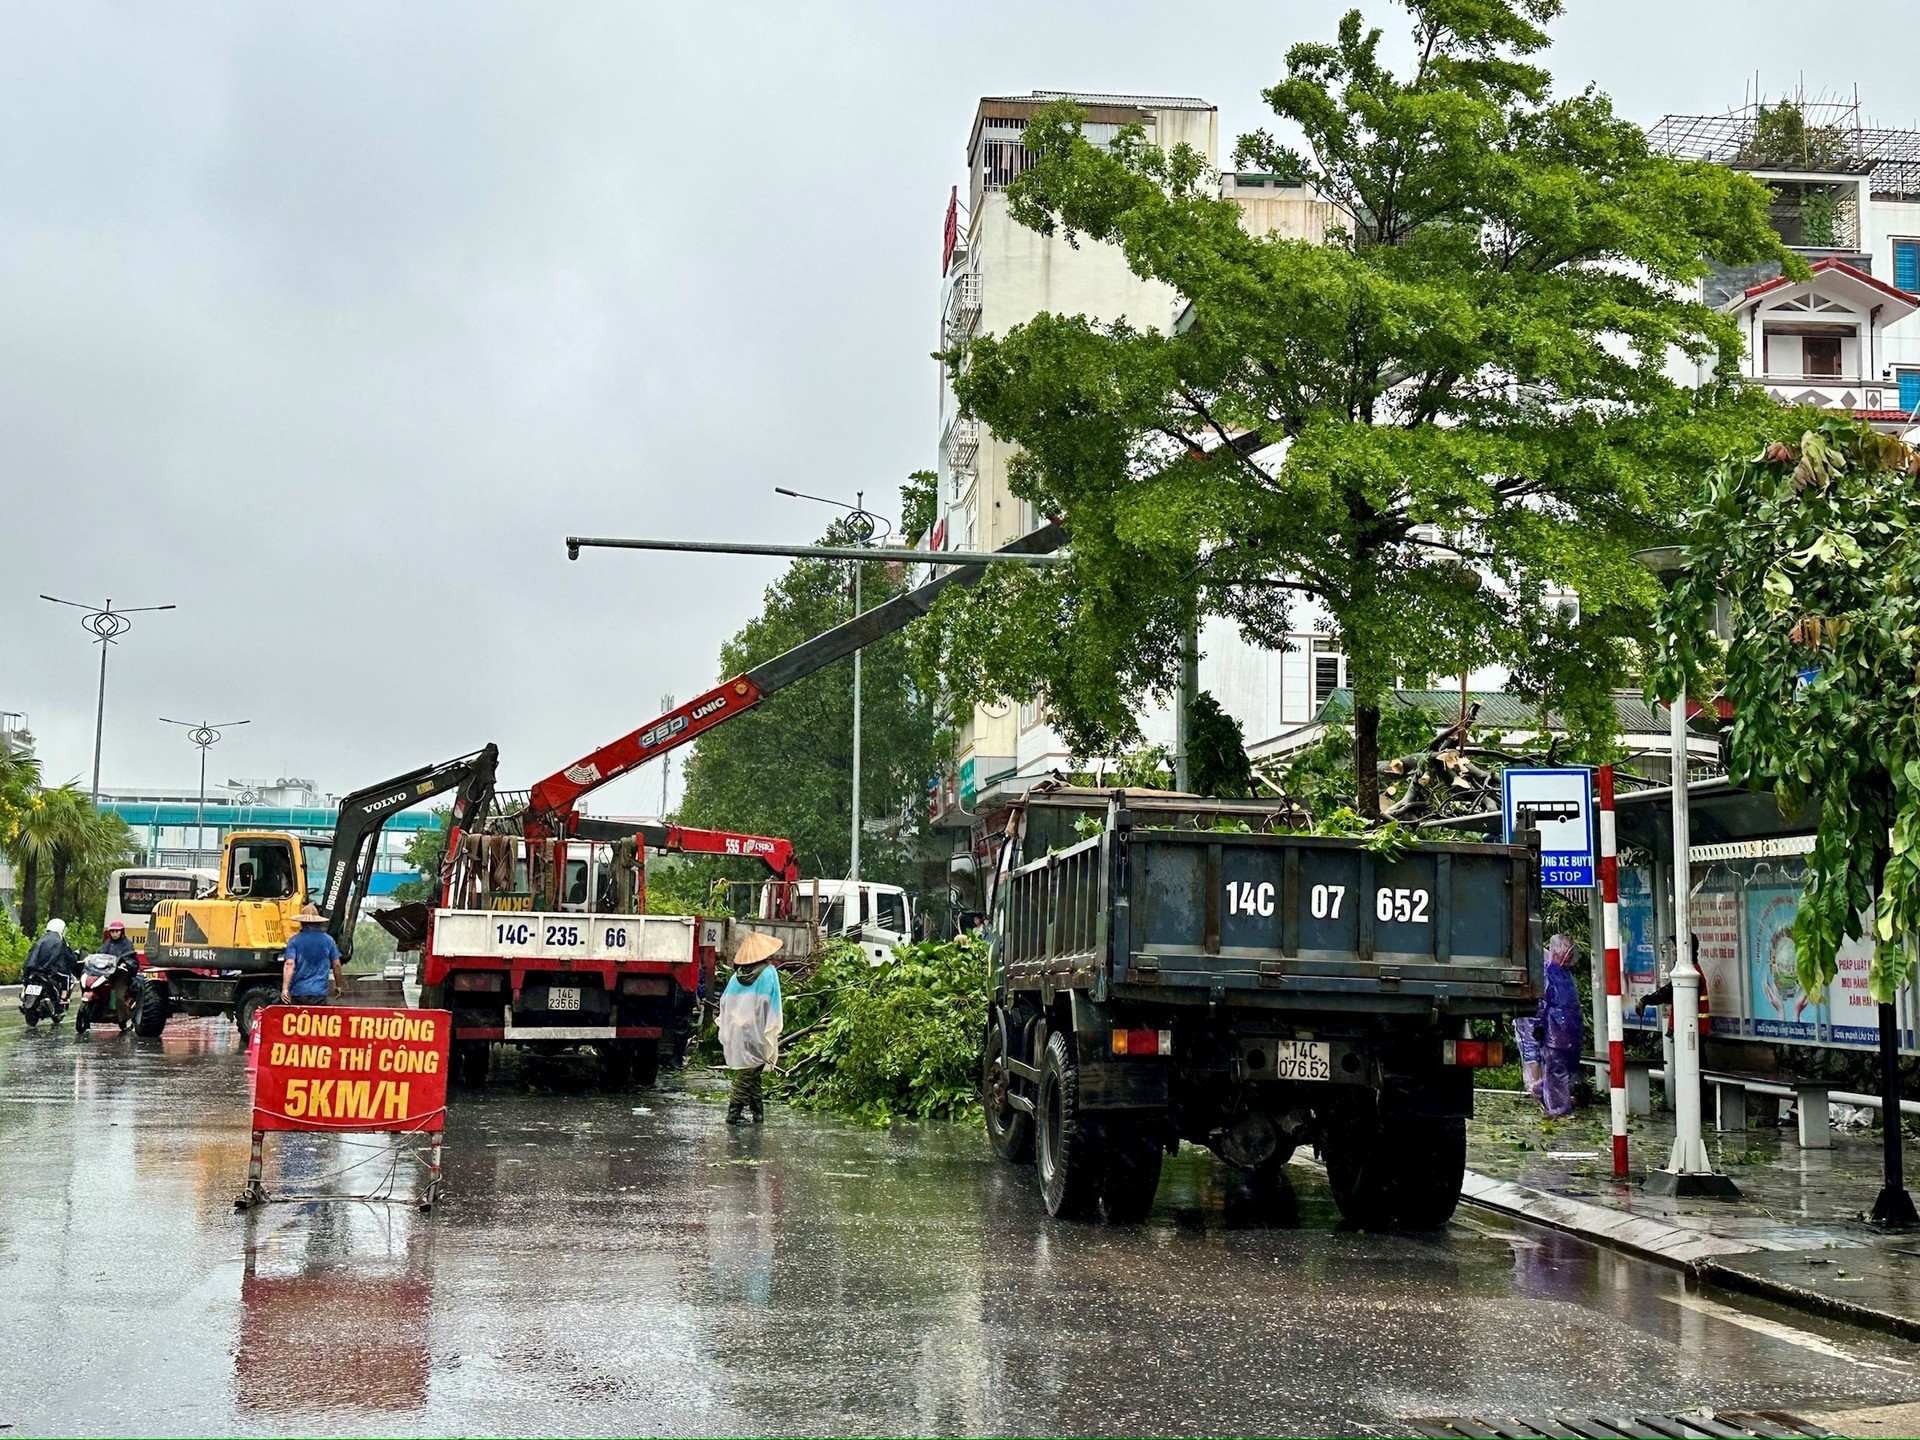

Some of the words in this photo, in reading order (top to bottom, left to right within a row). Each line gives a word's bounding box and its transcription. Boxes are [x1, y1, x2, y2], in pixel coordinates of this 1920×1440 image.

[641, 716, 684, 747] 360
[692, 697, 726, 720] UNIC
[363, 792, 407, 814] VOLVO
[726, 838, 740, 854] 555
[1559, 856, 1569, 867] XE
[1550, 871, 1582, 882] STOP
[1226, 881, 1275, 917] 14C
[1311, 884, 1345, 919] 07
[1376, 887, 1429, 923] 652
[605, 928, 627, 948] 66
[558, 988, 573, 998] 14C
[282, 1010, 342, 1038] CÔNG
[349, 1012, 435, 1042] TRƯỜNG
[271, 1043, 332, 1069] ĐANG
[379, 1045, 440, 1074] CÔNG
[1292, 1042, 1318, 1060] 14C
[284, 1079, 410, 1120] 5KM/H
